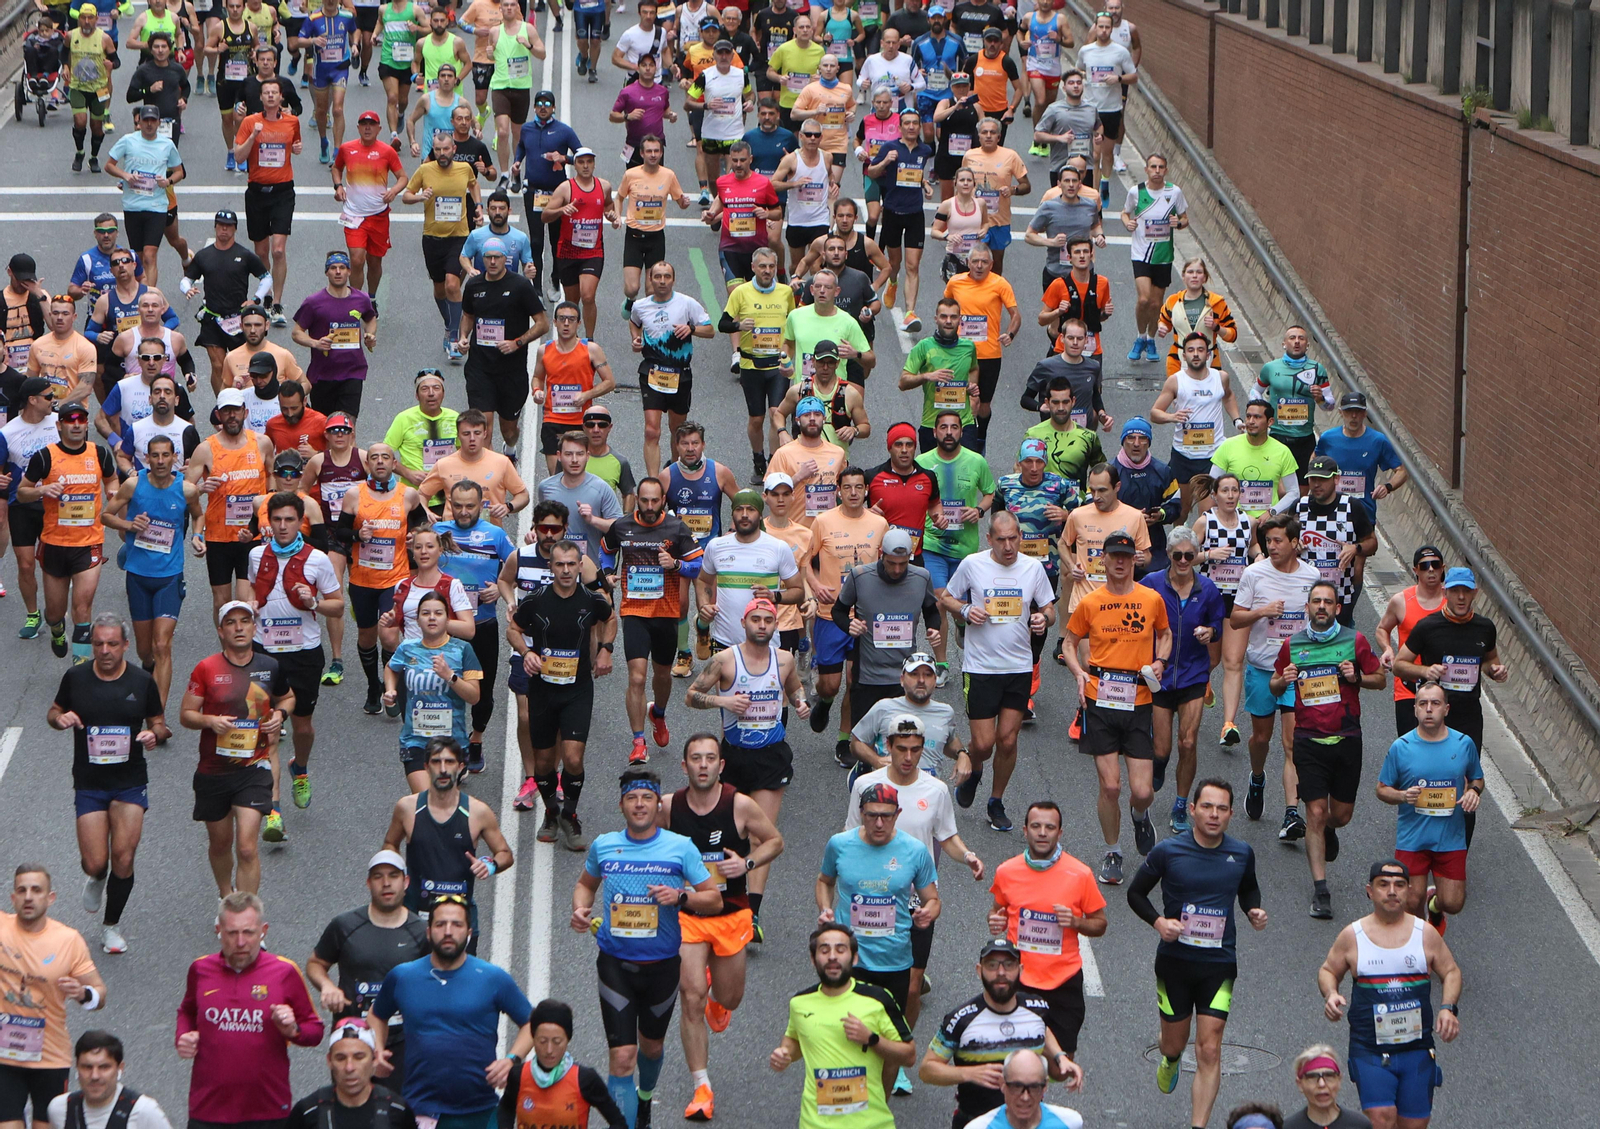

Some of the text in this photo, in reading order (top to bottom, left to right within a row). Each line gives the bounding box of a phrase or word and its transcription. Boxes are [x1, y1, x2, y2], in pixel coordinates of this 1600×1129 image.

[152, 520, 172, 528] ZURICH
[1102, 626, 1142, 634] TRIATHLON
[1310, 668, 1332, 676] ZURICH
[1112, 674, 1134, 682] ZURICH
[604, 861, 621, 872] C.A.
[436, 883, 463, 891] ZURICH
[625, 896, 652, 904] ZURICH
[1198, 906, 1224, 916] ZURICH
[1196, 920, 1211, 928] 7351
[1032, 936, 1060, 944] CARRASCO
[1390, 1002, 1416, 1012] ZURICH
[205, 1007, 264, 1024] QATAR
[946, 1004, 978, 1034] RAICES
[12, 1016, 40, 1028] ZURICH
[218, 1022, 264, 1033] AIRWAYS
[832, 1068, 860, 1078] ZURICH
